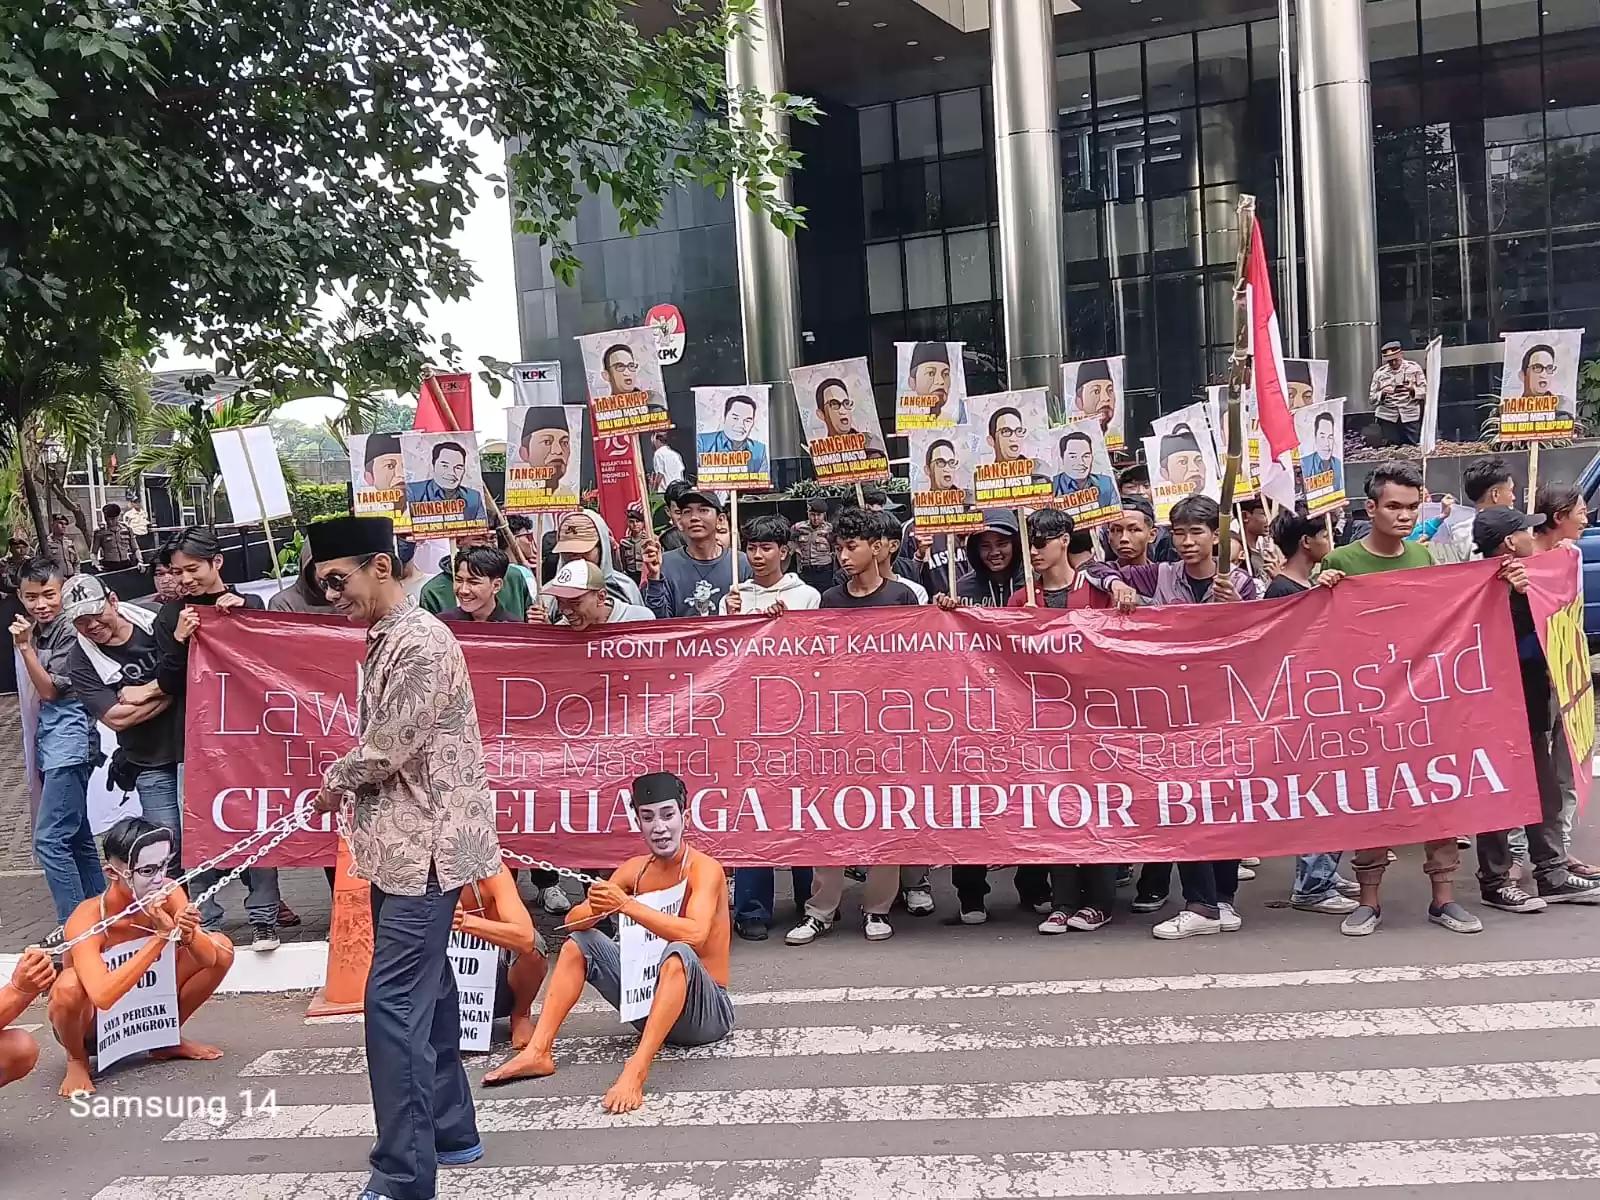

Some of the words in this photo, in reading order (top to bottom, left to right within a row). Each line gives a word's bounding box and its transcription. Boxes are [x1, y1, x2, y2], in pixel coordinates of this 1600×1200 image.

[522, 370, 546, 380] KPK
[594, 391, 648, 411] TANGKAP
[900, 396, 938, 407] TANGKAP
[1503, 396, 1558, 412] TANGKAP
[810, 433, 865, 456] TANGKAP
[600, 459, 632, 467] NUSANTARA
[700, 452, 751, 466] TANGKAP
[509, 467, 554, 481] TANGKAP
[976, 460, 1033, 480] TANGKAP
[356, 490, 401, 503] TANGKAP
[914, 490, 965, 506] TANGKAP
[1154, 482, 1195, 497] TANGKAP
[412, 499, 465, 515] TANGKAP
[587, 639, 669, 658] FRONT
[676, 635, 839, 657] MASYARAKAT
[848, 632, 1002, 654] KALIMANTAN
[1007, 633, 1084, 655] TIMUR
[214, 672, 361, 737] Law
[496, 672, 726, 739] Politik
[750, 667, 1003, 737] Dinasti
[1024, 664, 1200, 732] Bani
[1219, 623, 1494, 725] Mas'ud
[734, 736, 906, 777] Rahmad
[919, 732, 1075, 773] Mas'ud
[1090, 733, 1124, 772] &
[1136, 727, 1257, 777] Rudy
[1272, 706, 1435, 764] Mas'ud
[788, 783, 1140, 832] KORUPTOR
[1155, 748, 1510, 827] BERKUASA
[626, 985, 652, 1005] UANG
[103, 1016, 120, 1034] SAYA
[122, 1003, 167, 1023] PERUSAK
[98, 1031, 121, 1053] HUTAN
[122, 1017, 177, 1039] MANGROVE
